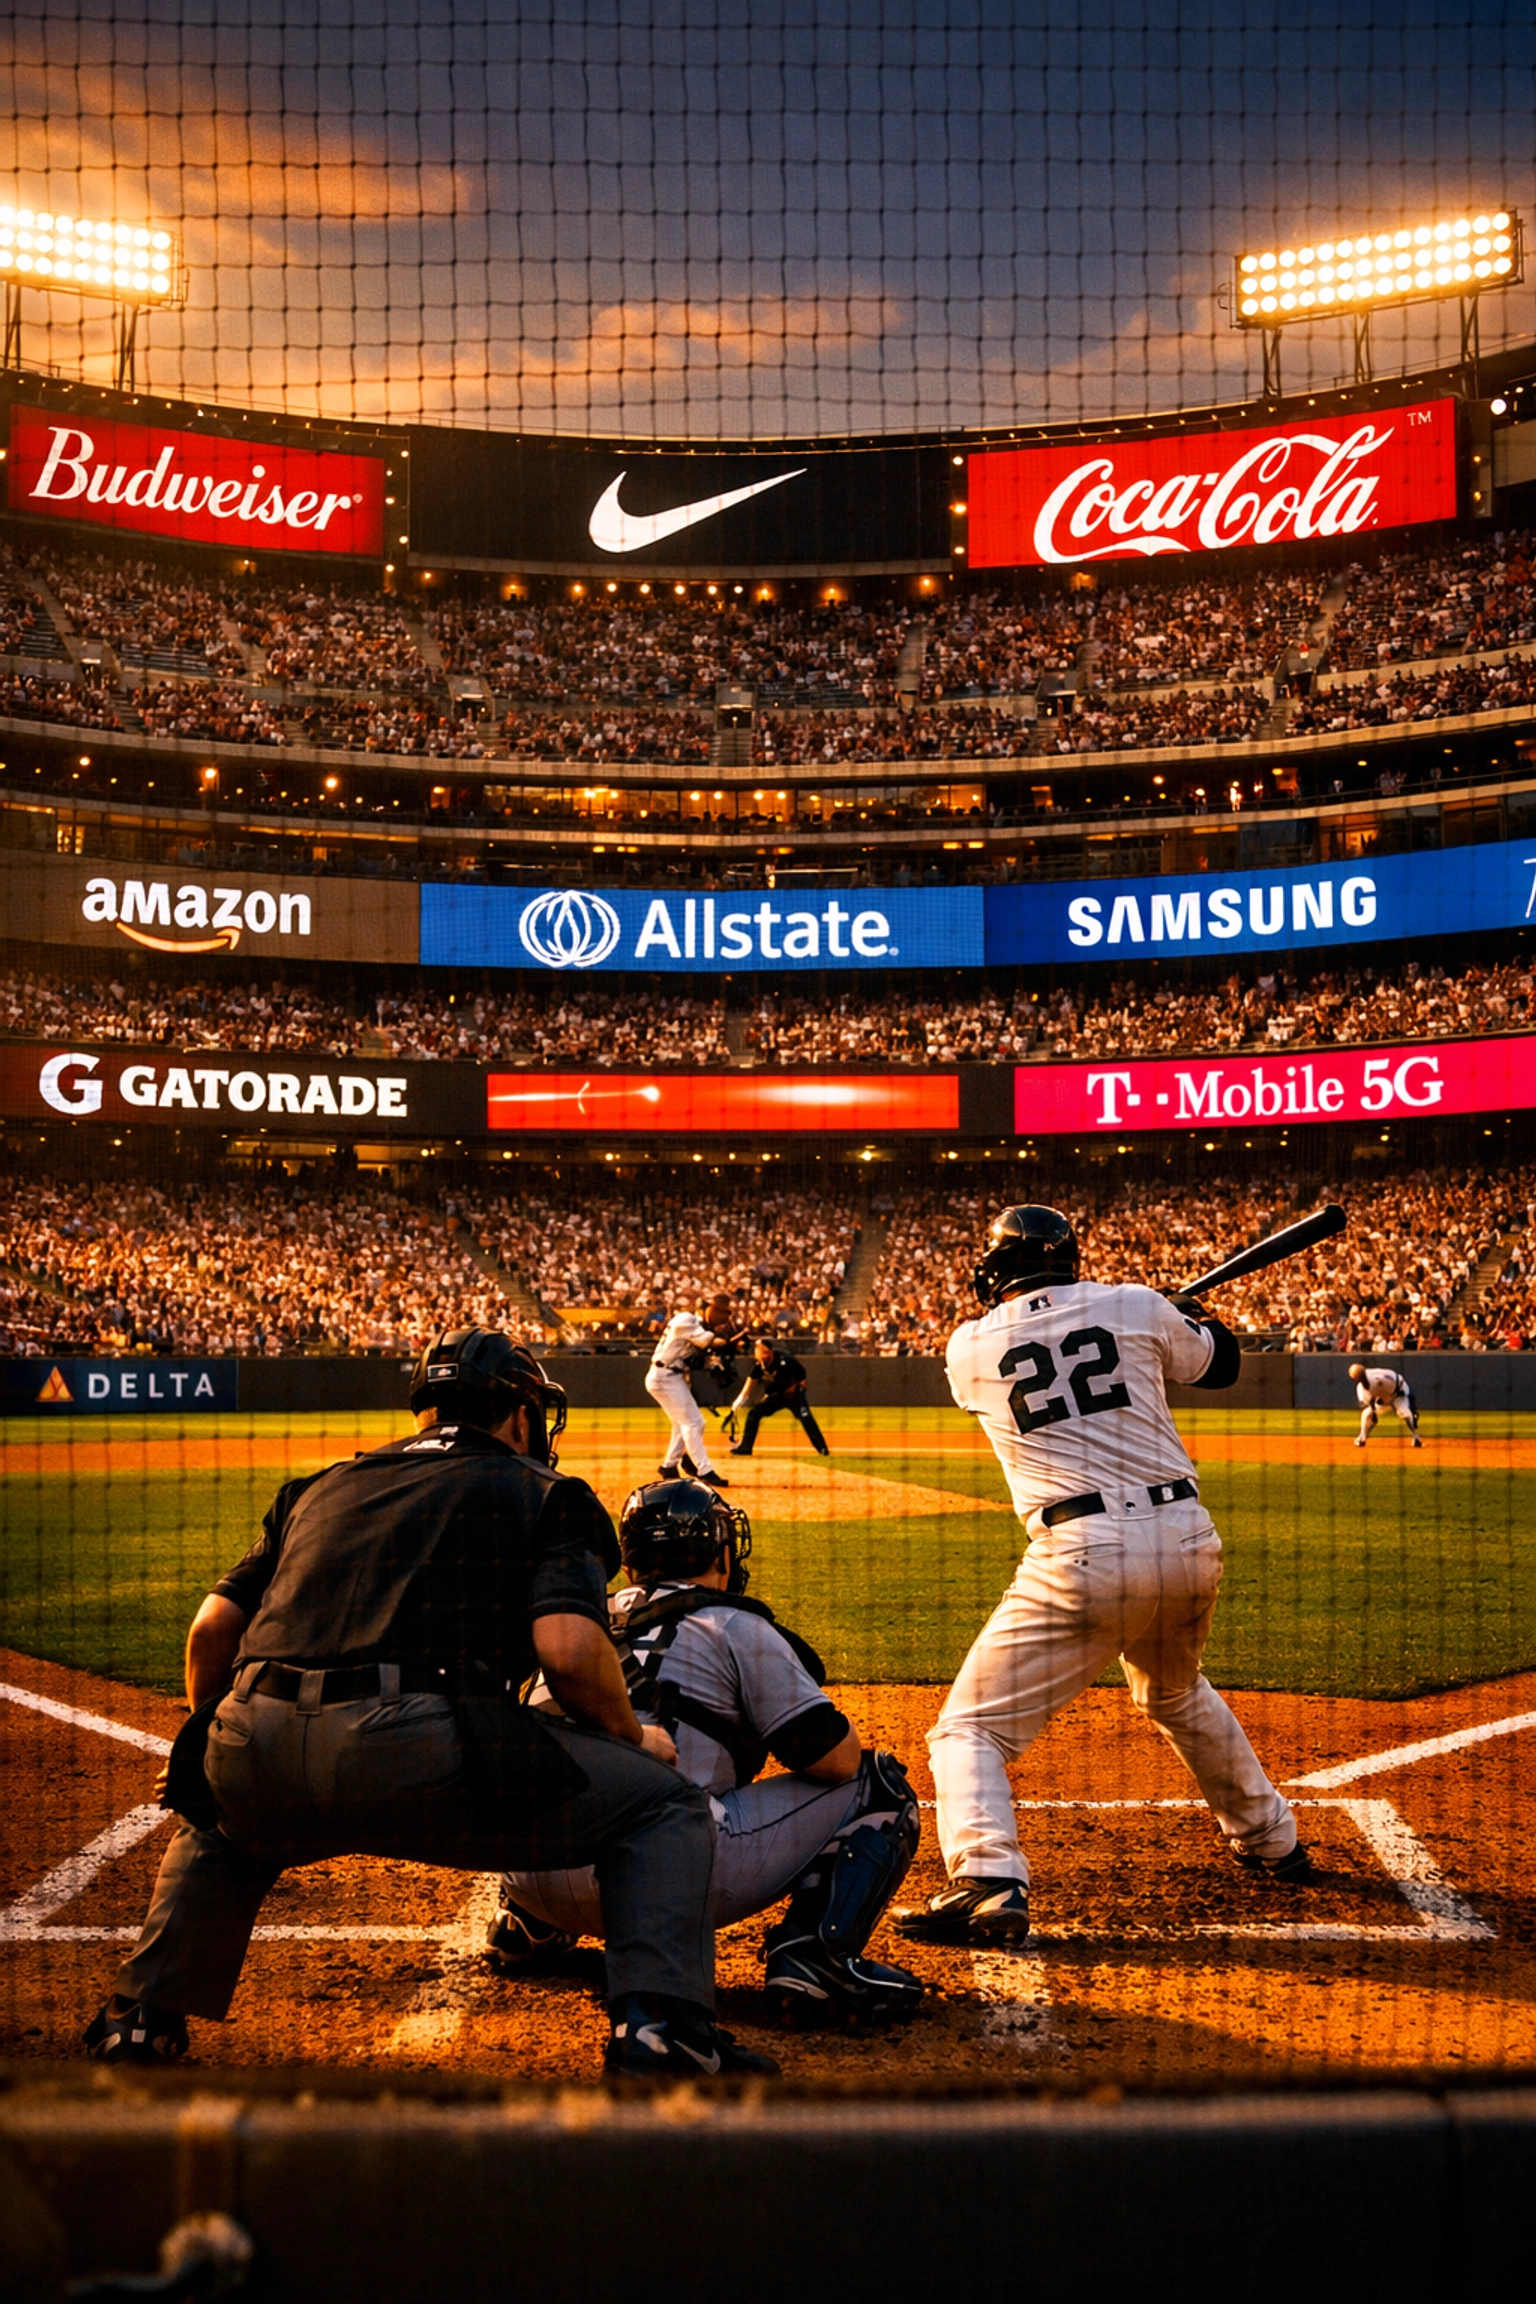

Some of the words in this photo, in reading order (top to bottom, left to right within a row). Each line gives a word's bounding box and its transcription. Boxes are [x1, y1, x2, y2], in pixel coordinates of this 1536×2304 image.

[28, 426, 352, 531] Budweiser
[1033, 424, 1395, 564] Coca-Cola
[634, 898, 891, 959] Allstate
[1067, 876, 1377, 947] SAMSUNG
[119, 1065, 408, 1117] GATORADE
[1360, 1056, 1444, 1111] 5G
[88, 1372, 215, 1399] DELTA
[999, 1325, 1133, 1435] 22
